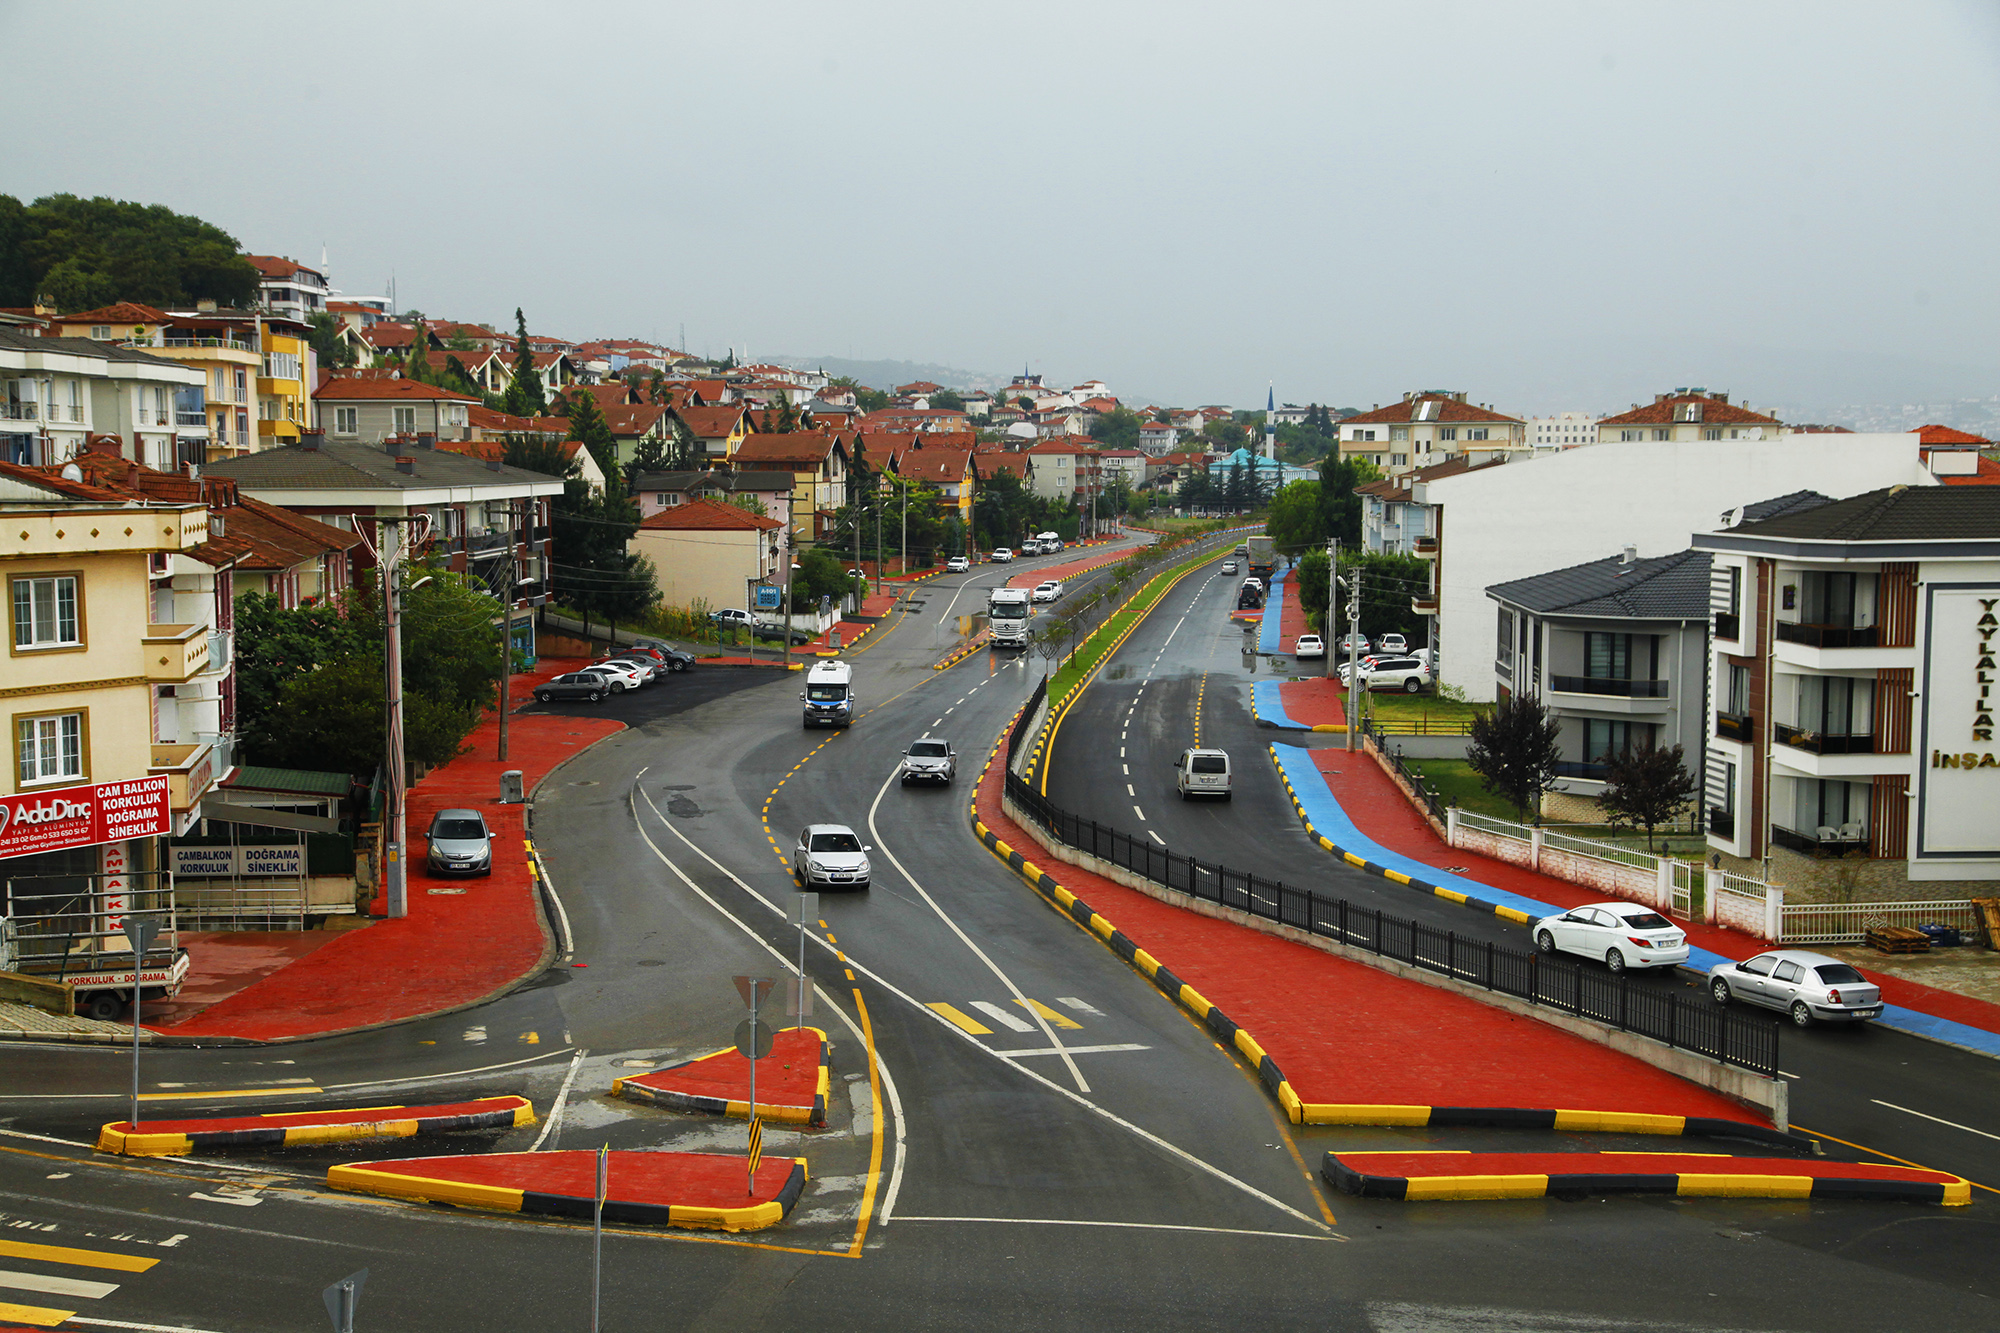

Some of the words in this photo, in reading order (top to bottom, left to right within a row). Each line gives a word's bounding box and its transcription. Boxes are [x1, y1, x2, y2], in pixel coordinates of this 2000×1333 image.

[1972, 598, 2000, 741] YAYLALILAR
[1932, 750, 2000, 770] İNŞA
[97, 785, 120, 798] CAM
[124, 779, 166, 794] BALKON
[103, 792, 161, 810] KORKULUK
[12, 799, 91, 826] AdaDinç
[106, 807, 159, 824] DOĞRAMA
[44, 820, 91, 831] ALÜMİNYUM
[108, 820, 158, 838] SİNEKLİK
[177, 851, 232, 860] CAMBALKON
[246, 849, 300, 860] DOĞRAMA
[180, 863, 229, 873] KORKULUK
[248, 861, 298, 872] SİNEKLİK
